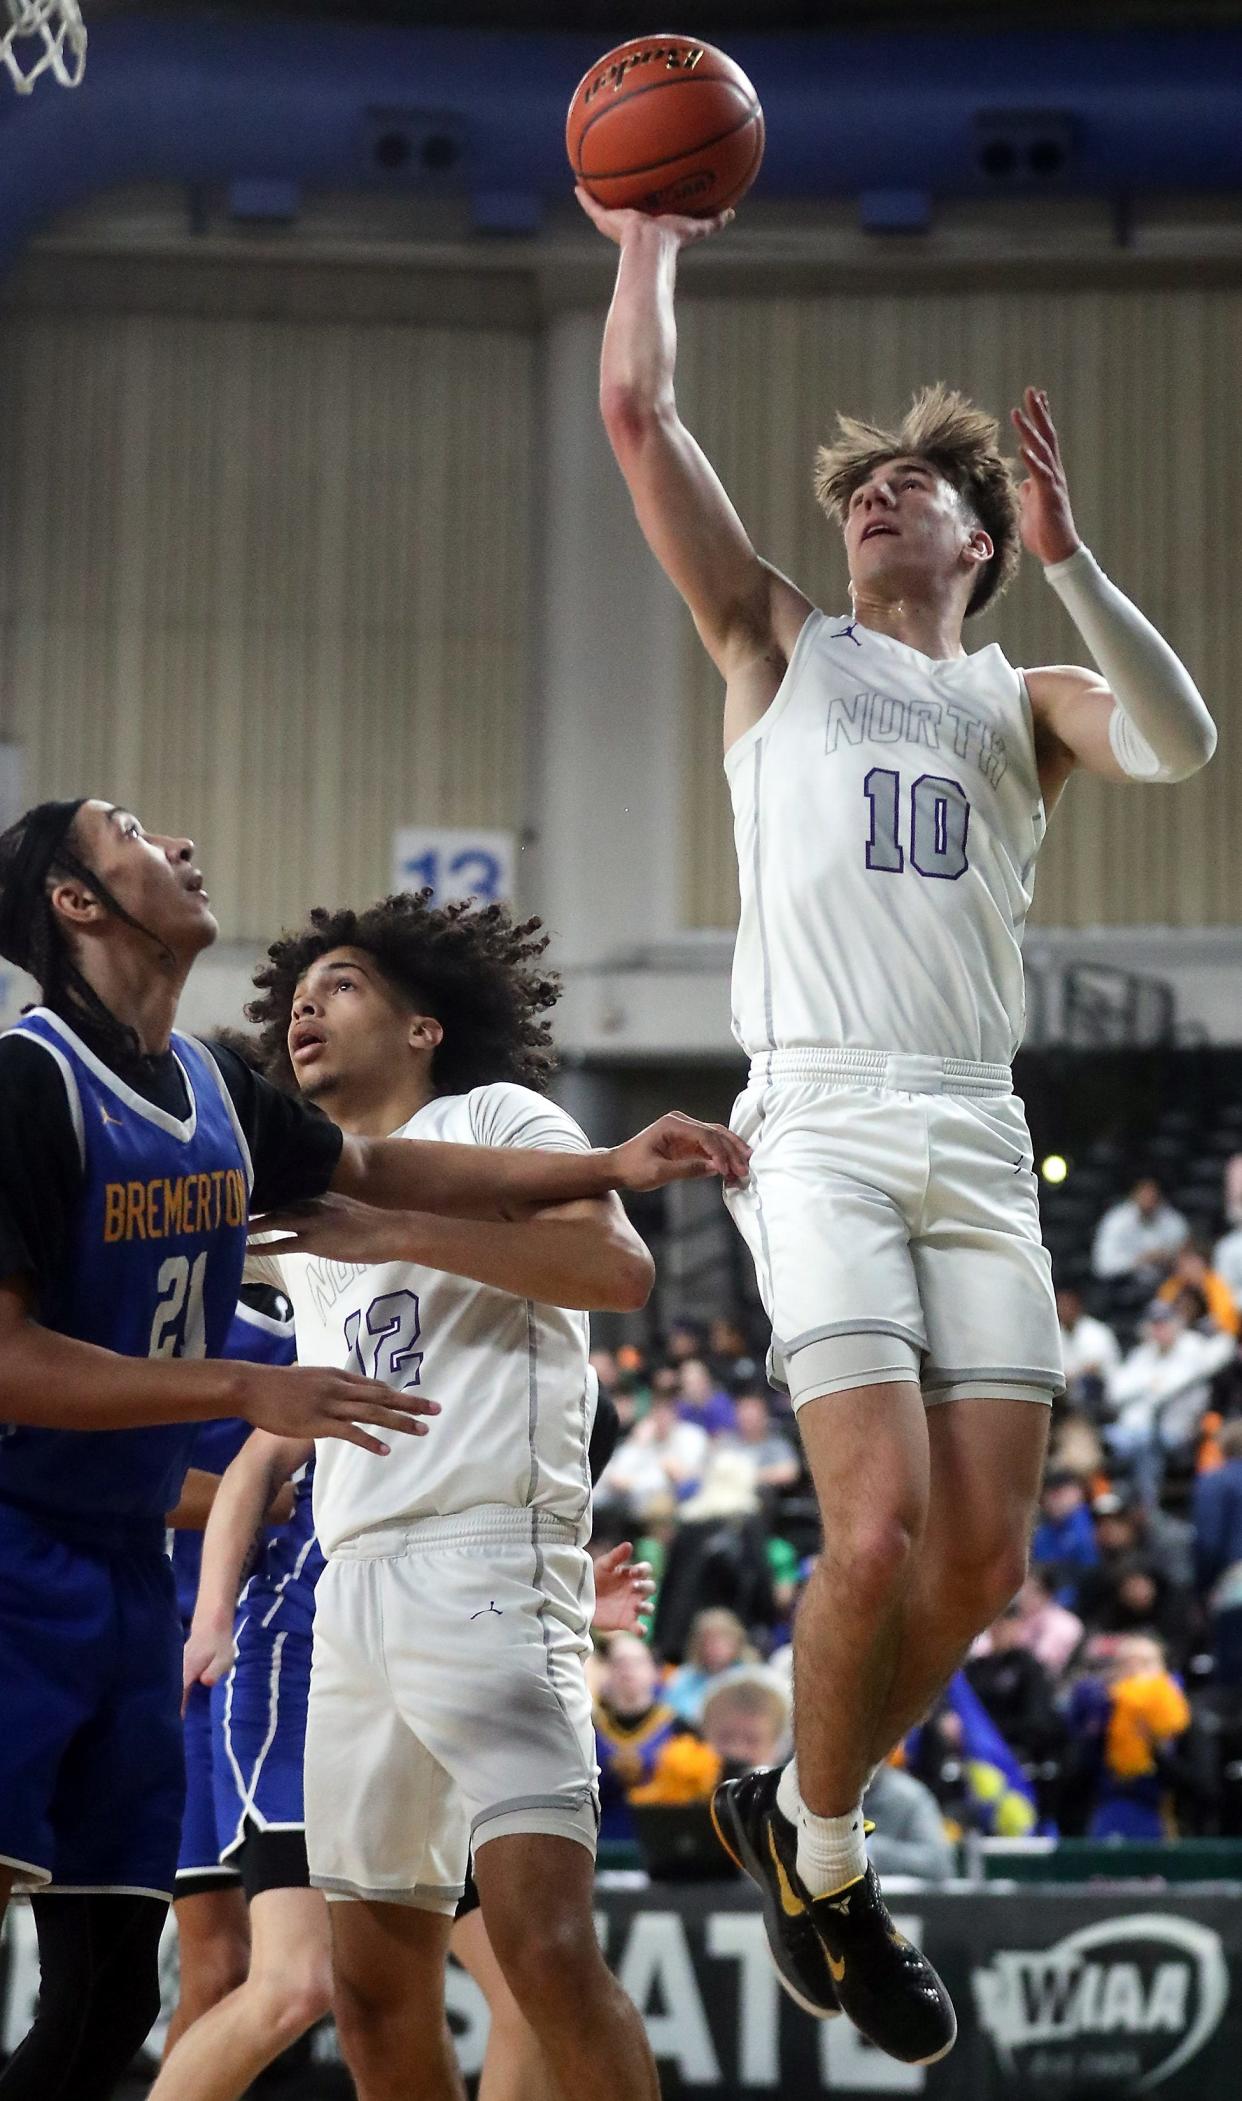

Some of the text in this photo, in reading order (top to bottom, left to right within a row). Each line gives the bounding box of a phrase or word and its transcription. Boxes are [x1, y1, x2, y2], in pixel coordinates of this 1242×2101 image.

[863, 766, 971, 880] 10
[402, 846, 501, 912] 13
[103, 1168, 247, 1243] BREMERTON
[147, 1251, 208, 1360] 21
[344, 1288, 424, 1391] 12
